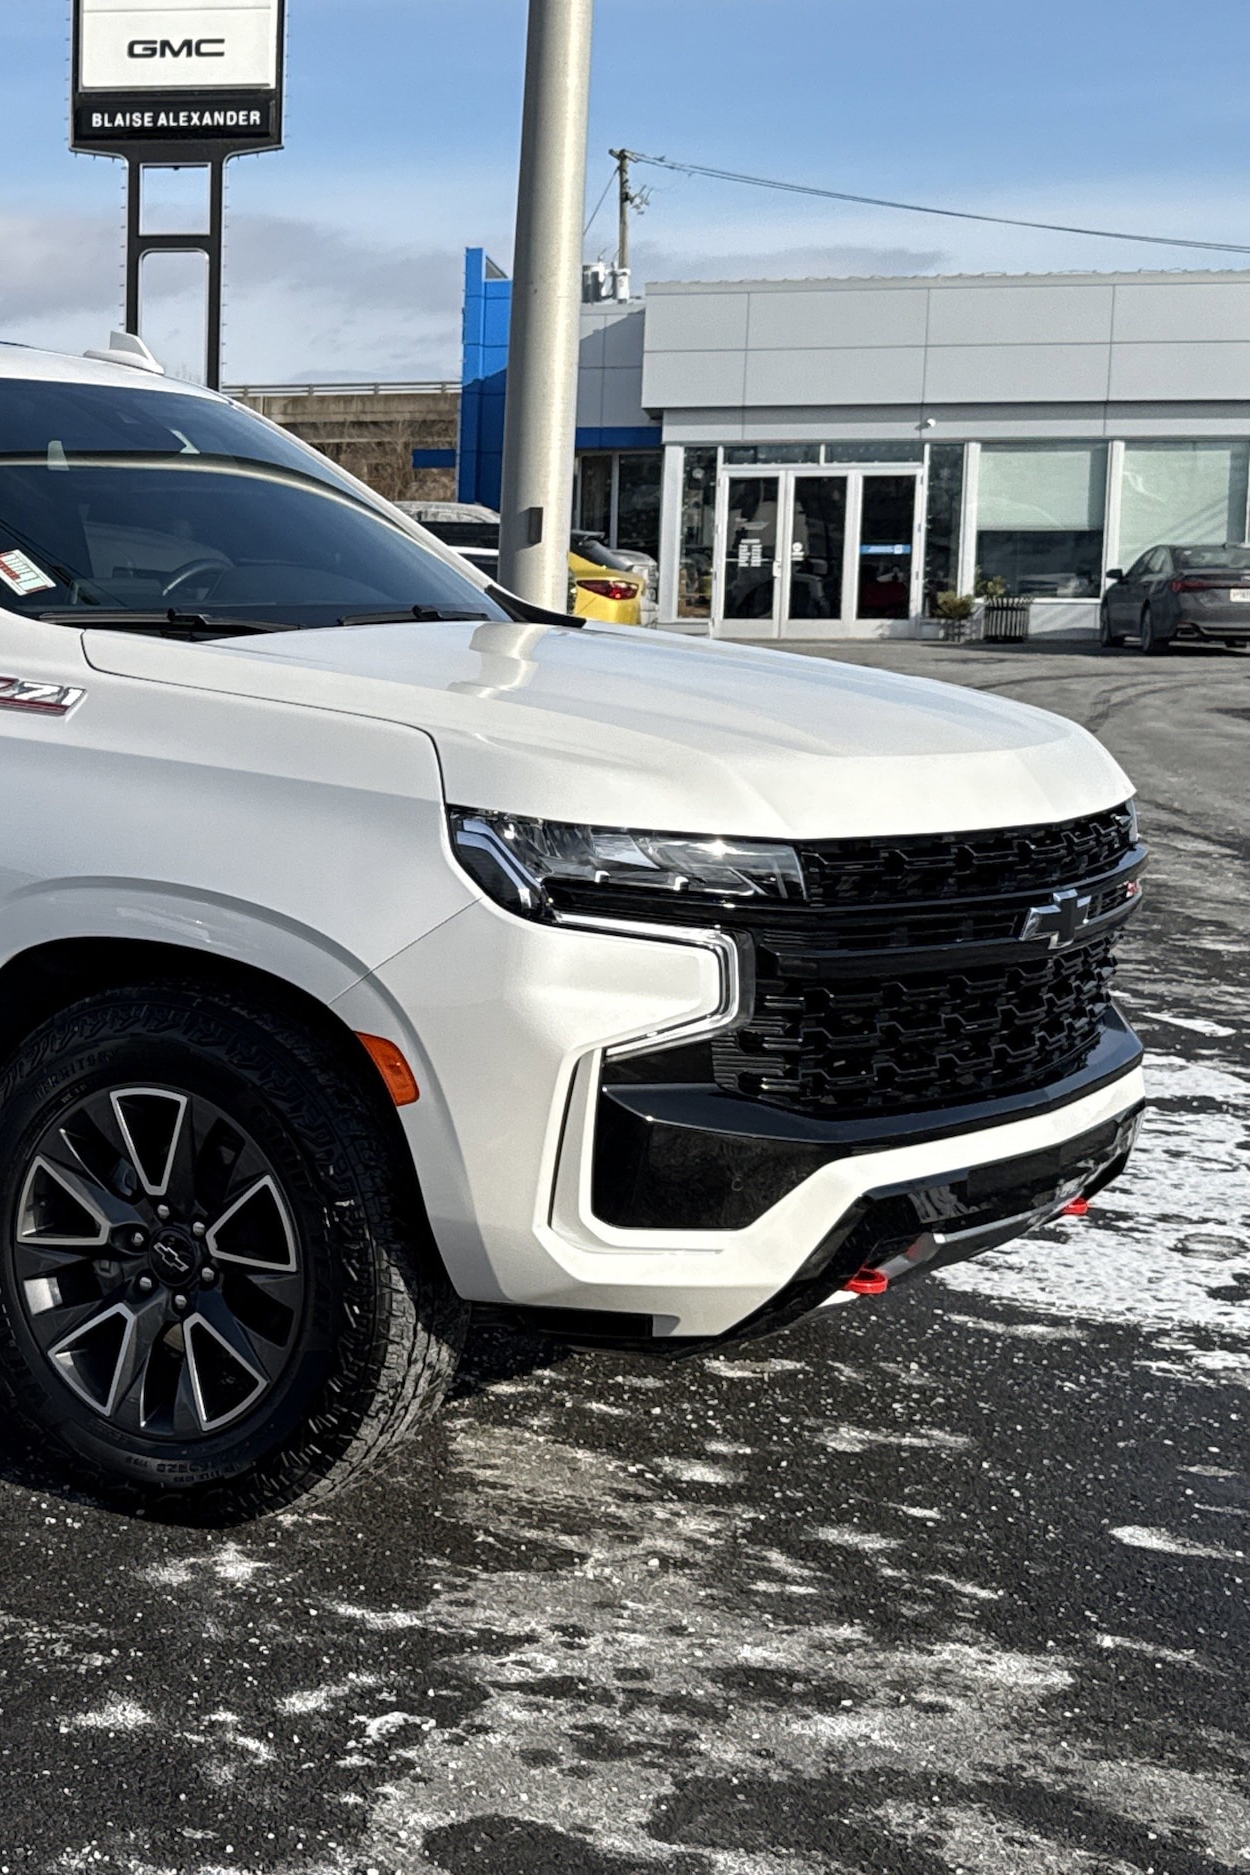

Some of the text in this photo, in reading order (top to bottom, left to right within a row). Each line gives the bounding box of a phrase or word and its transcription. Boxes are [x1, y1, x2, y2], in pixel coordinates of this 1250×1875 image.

[127, 38, 225, 59] GMC
[91, 110, 261, 128] BLAISE ALEXANDER
